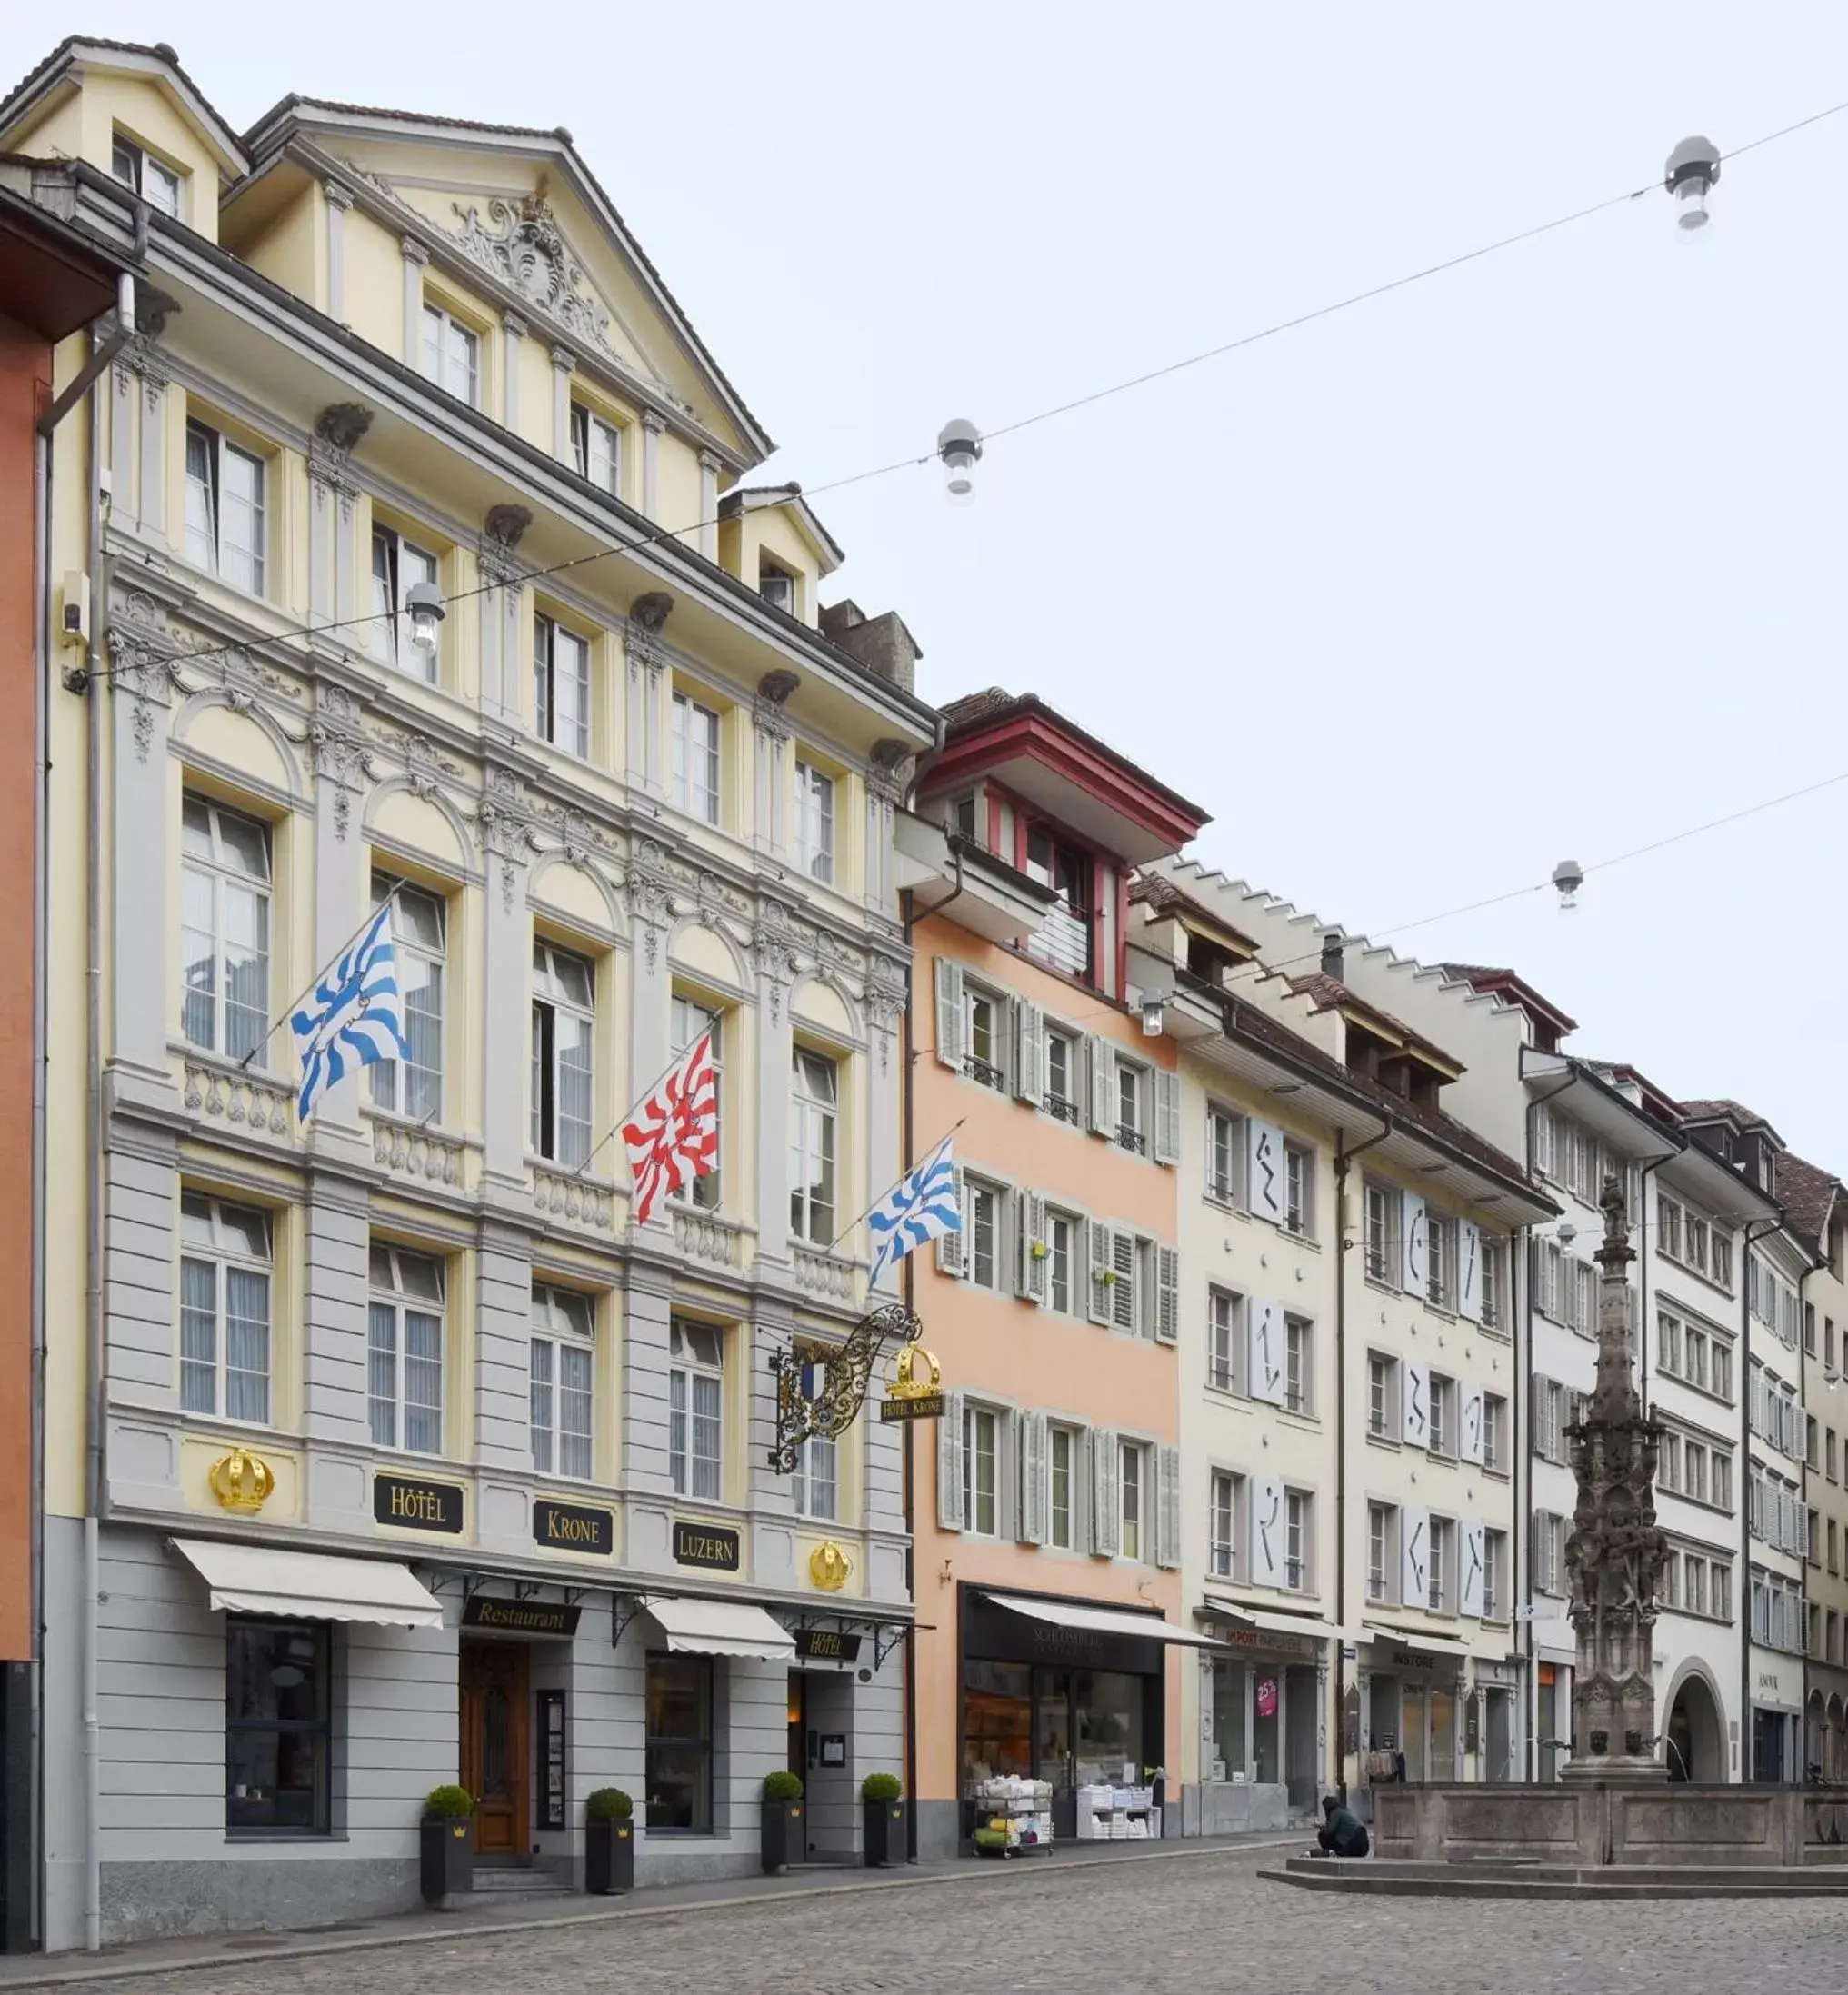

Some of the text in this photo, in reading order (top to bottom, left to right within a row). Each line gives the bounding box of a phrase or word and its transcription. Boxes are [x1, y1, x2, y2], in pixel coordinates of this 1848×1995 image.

[884, 1399, 942, 1418] HOTEL KRONE
[547, 1510, 601, 1543] KRONE
[679, 1530, 734, 1561] LUZERN
[477, 1601, 565, 1629] Restaurant
[809, 1632, 843, 1656] HOTEL
[1392, 1651, 1436, 1669] INSTORE
